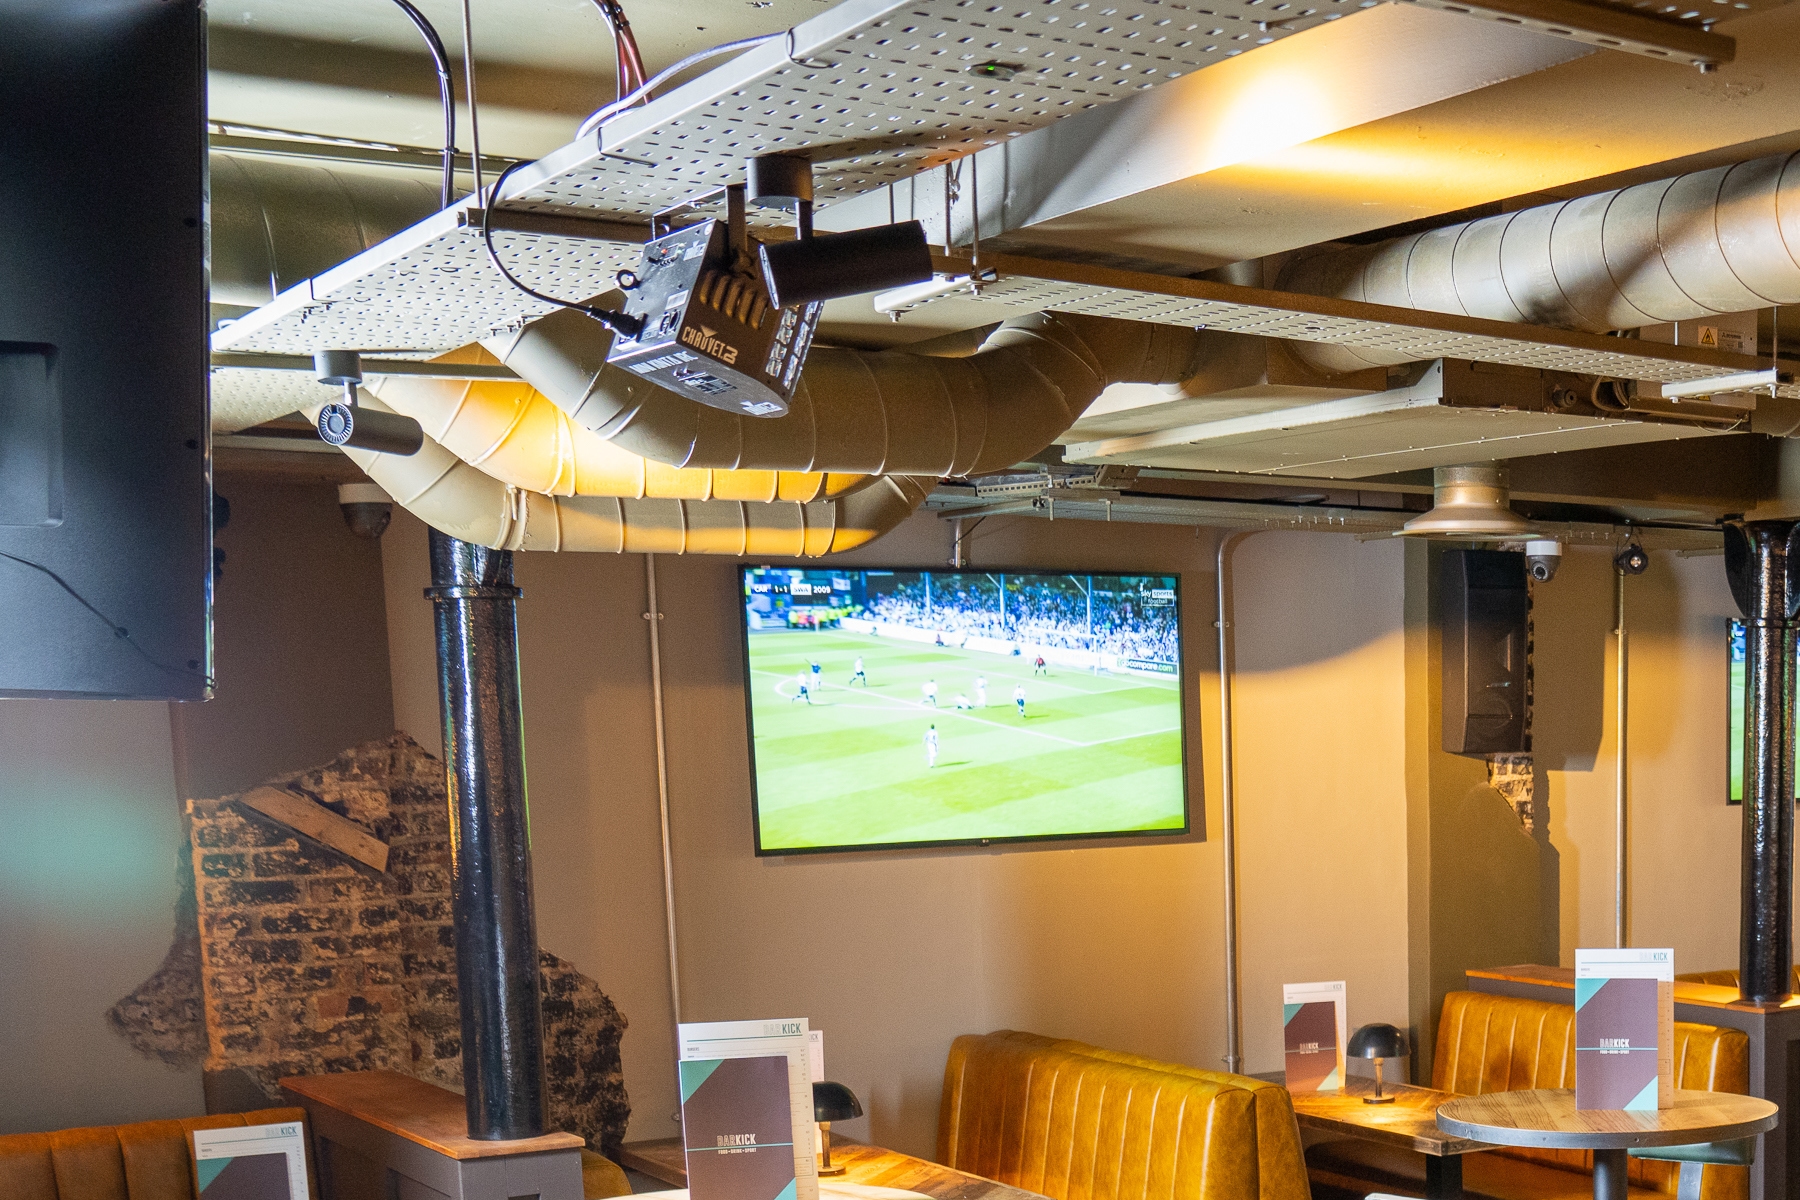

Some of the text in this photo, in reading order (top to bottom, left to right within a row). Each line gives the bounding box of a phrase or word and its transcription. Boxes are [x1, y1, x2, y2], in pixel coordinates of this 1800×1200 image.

[1653, 953, 1668, 961] KICK
[782, 1023, 802, 1034] KICK
[280, 1126, 297, 1135] KICK
